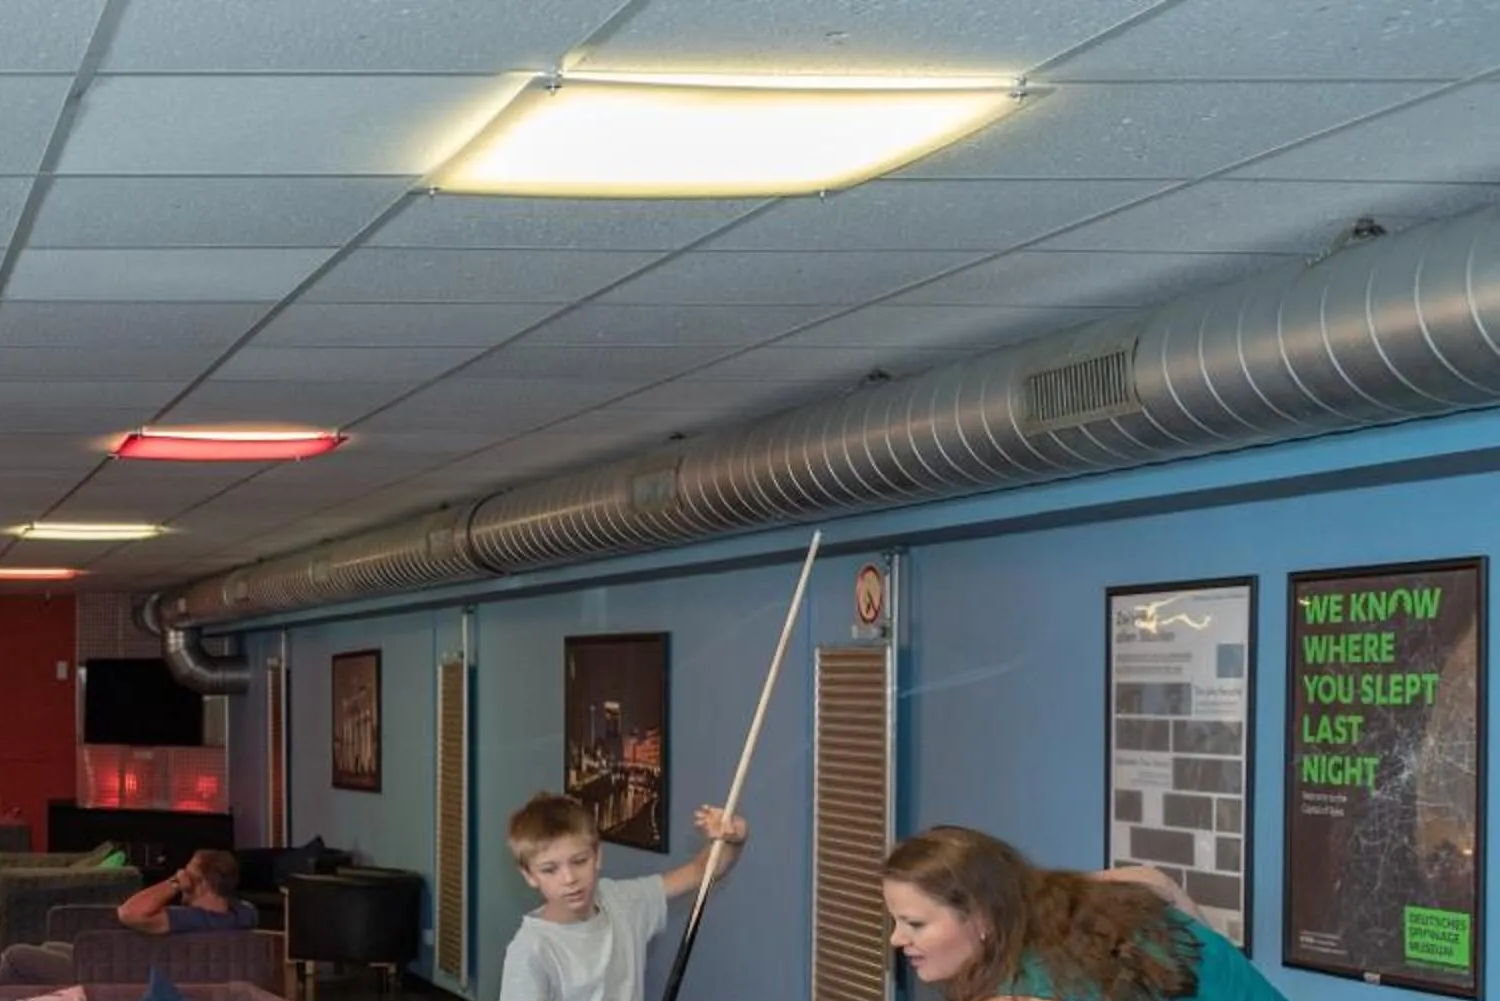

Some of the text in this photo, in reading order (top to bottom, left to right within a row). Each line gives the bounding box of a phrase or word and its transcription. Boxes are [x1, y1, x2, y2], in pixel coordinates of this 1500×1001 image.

[1304, 588, 1442, 624] WE KNOW
[1304, 632, 1395, 664] WHERE
[1304, 673, 1440, 705] YOU SLEPT
[1303, 714, 1364, 744] LAST
[1303, 755, 1380, 788] NIGHT
